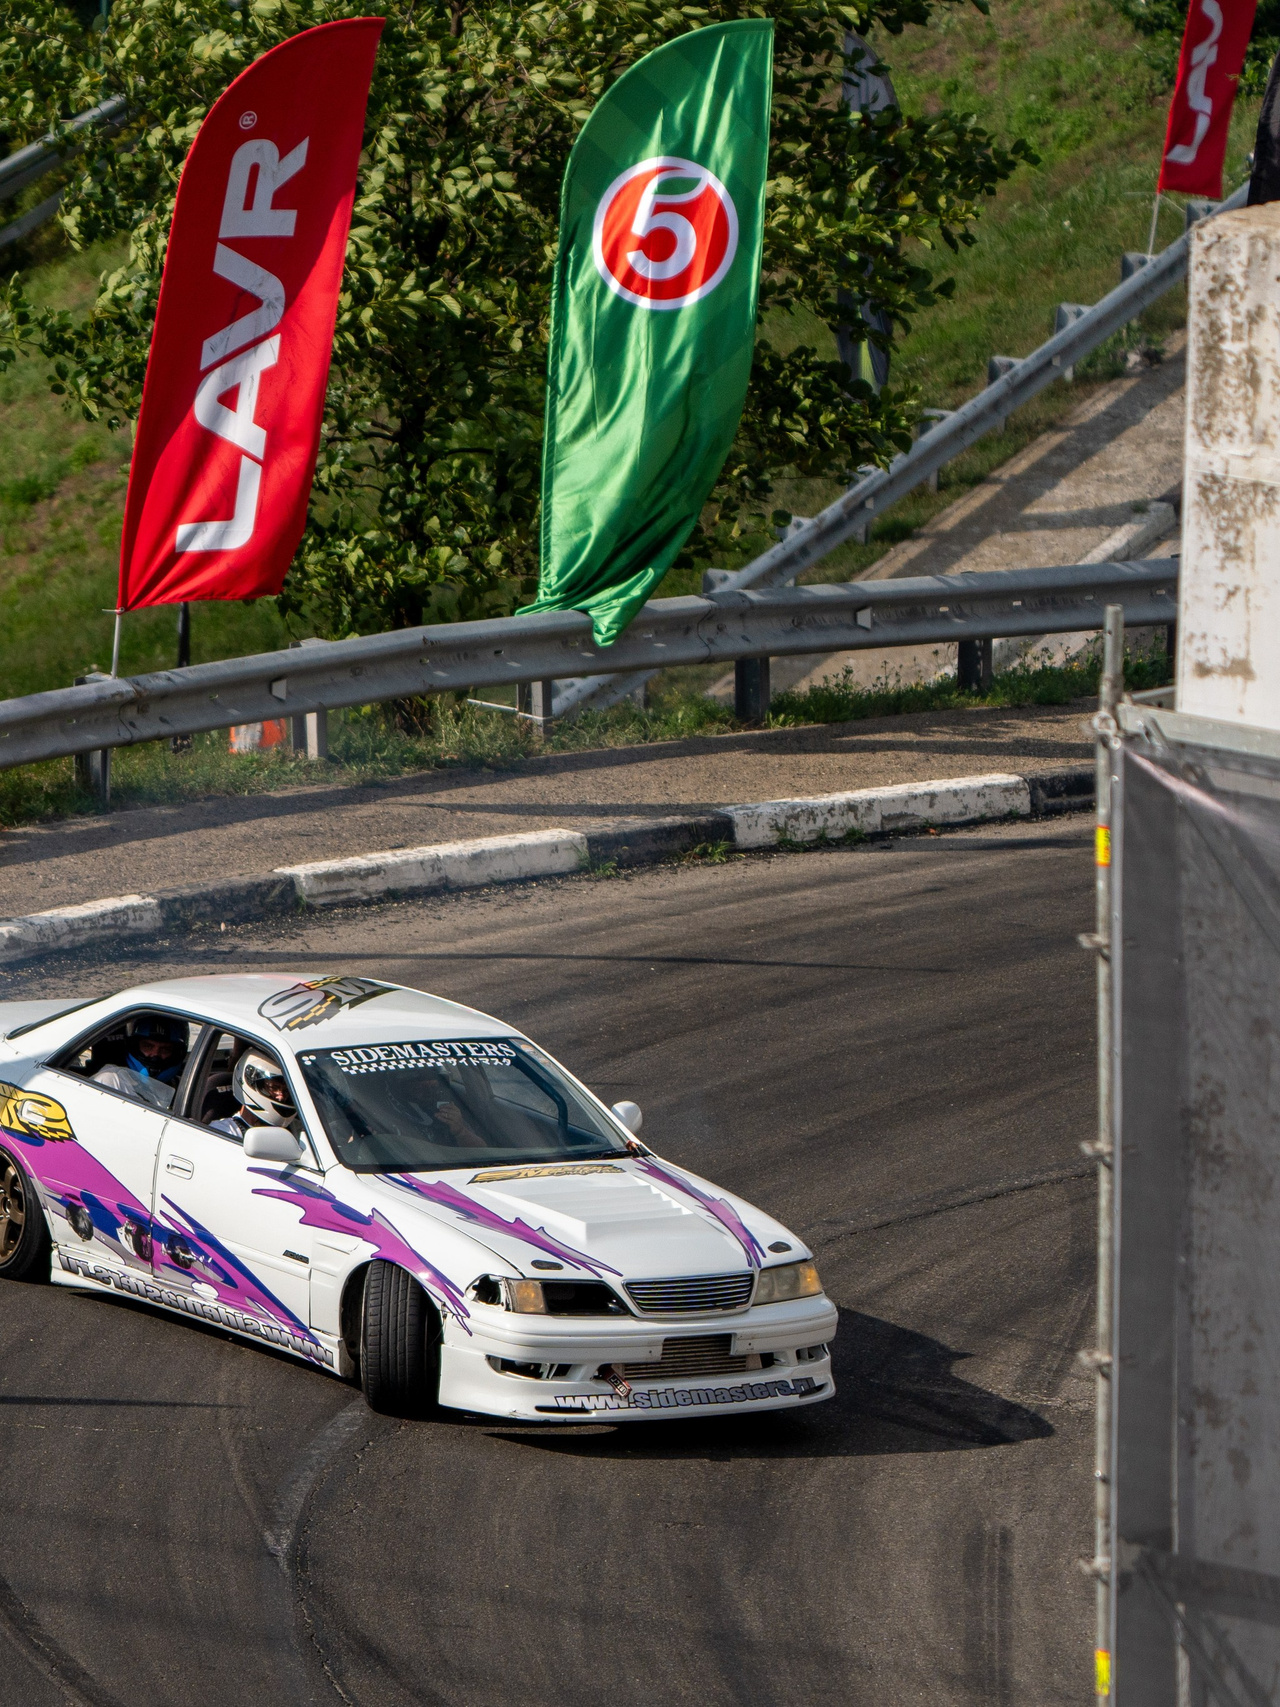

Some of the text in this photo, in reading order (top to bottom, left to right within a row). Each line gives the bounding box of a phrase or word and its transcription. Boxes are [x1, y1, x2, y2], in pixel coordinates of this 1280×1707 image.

[1166, 0, 1224, 165] LAV
[626, 169, 709, 281] 5
[330, 1042, 517, 1066] SIDEMASTERS
[555, 1376, 815, 1411] www.sidemasters.ru
